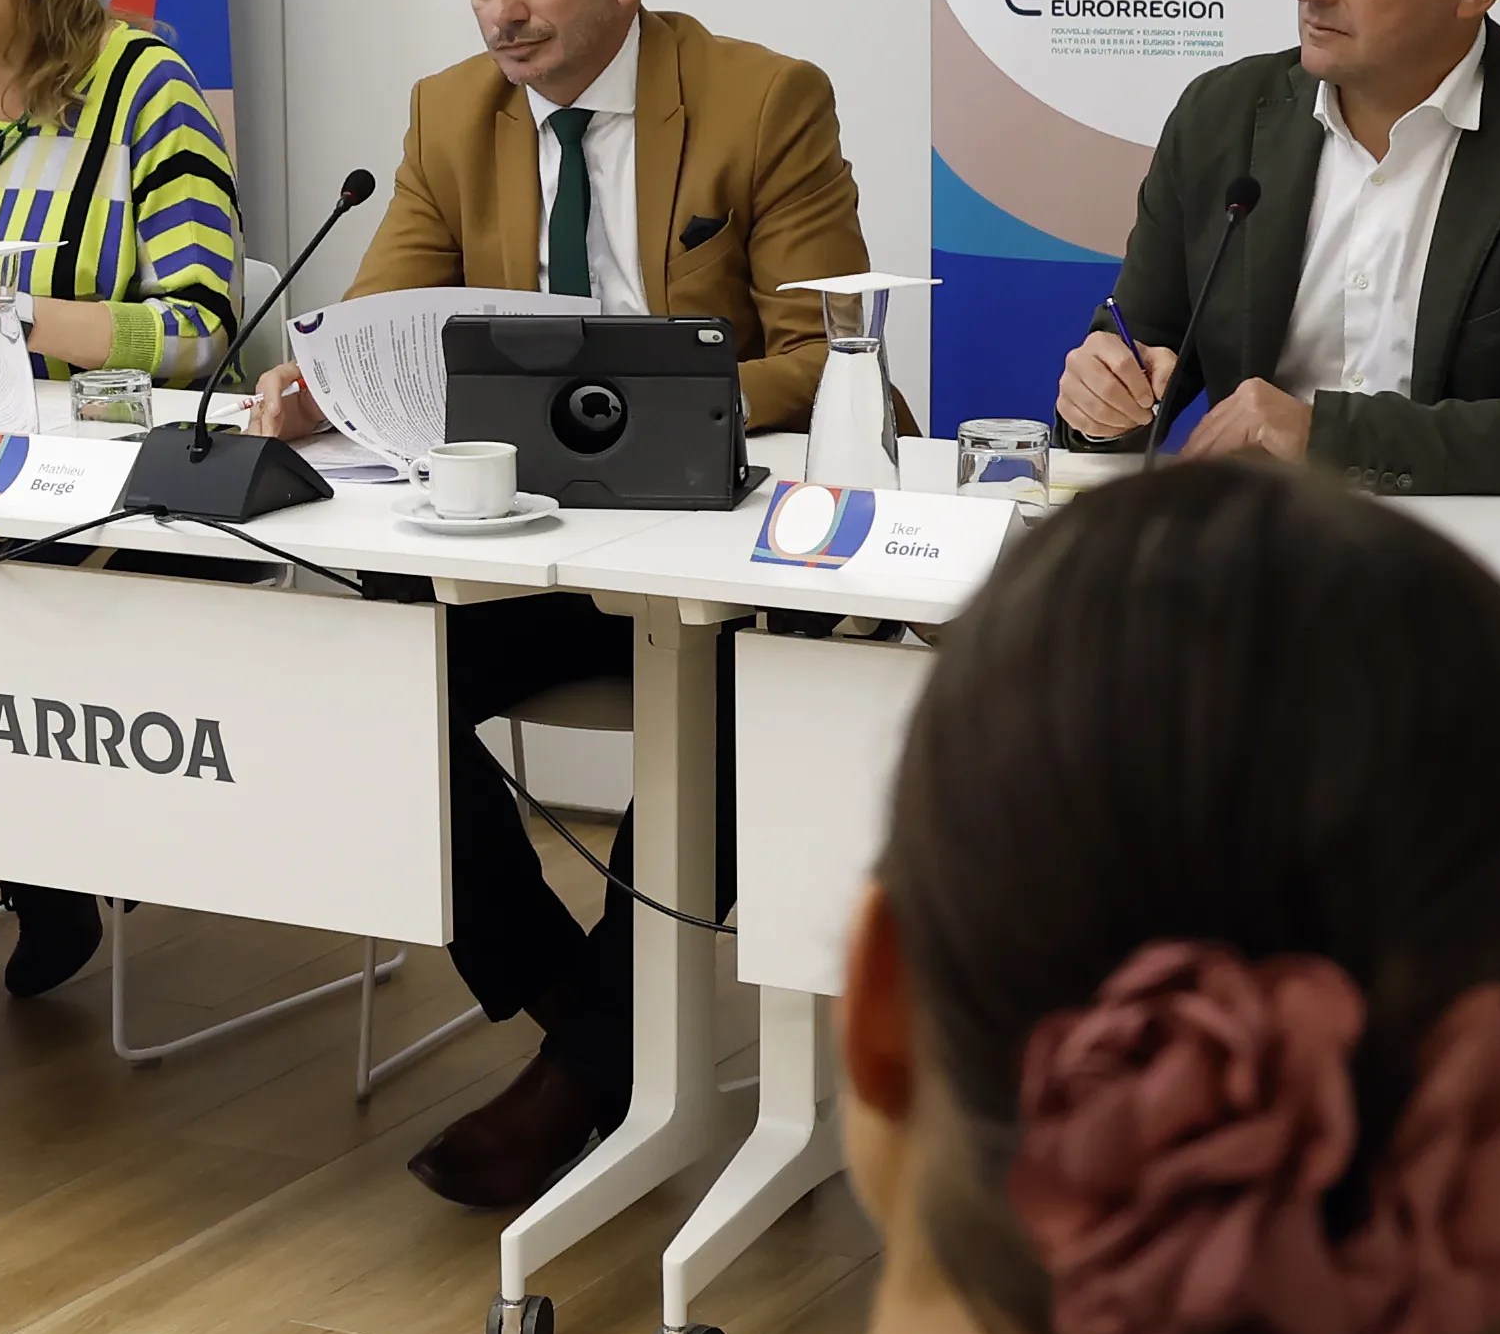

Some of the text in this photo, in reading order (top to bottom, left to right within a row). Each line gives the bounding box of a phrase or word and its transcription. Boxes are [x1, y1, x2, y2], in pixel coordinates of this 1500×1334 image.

[37, 461, 86, 477] Mathieu
[29, 477, 75, 496] Bergé
[890, 522, 922, 537] Iker
[884, 541, 940, 560] Goiria
